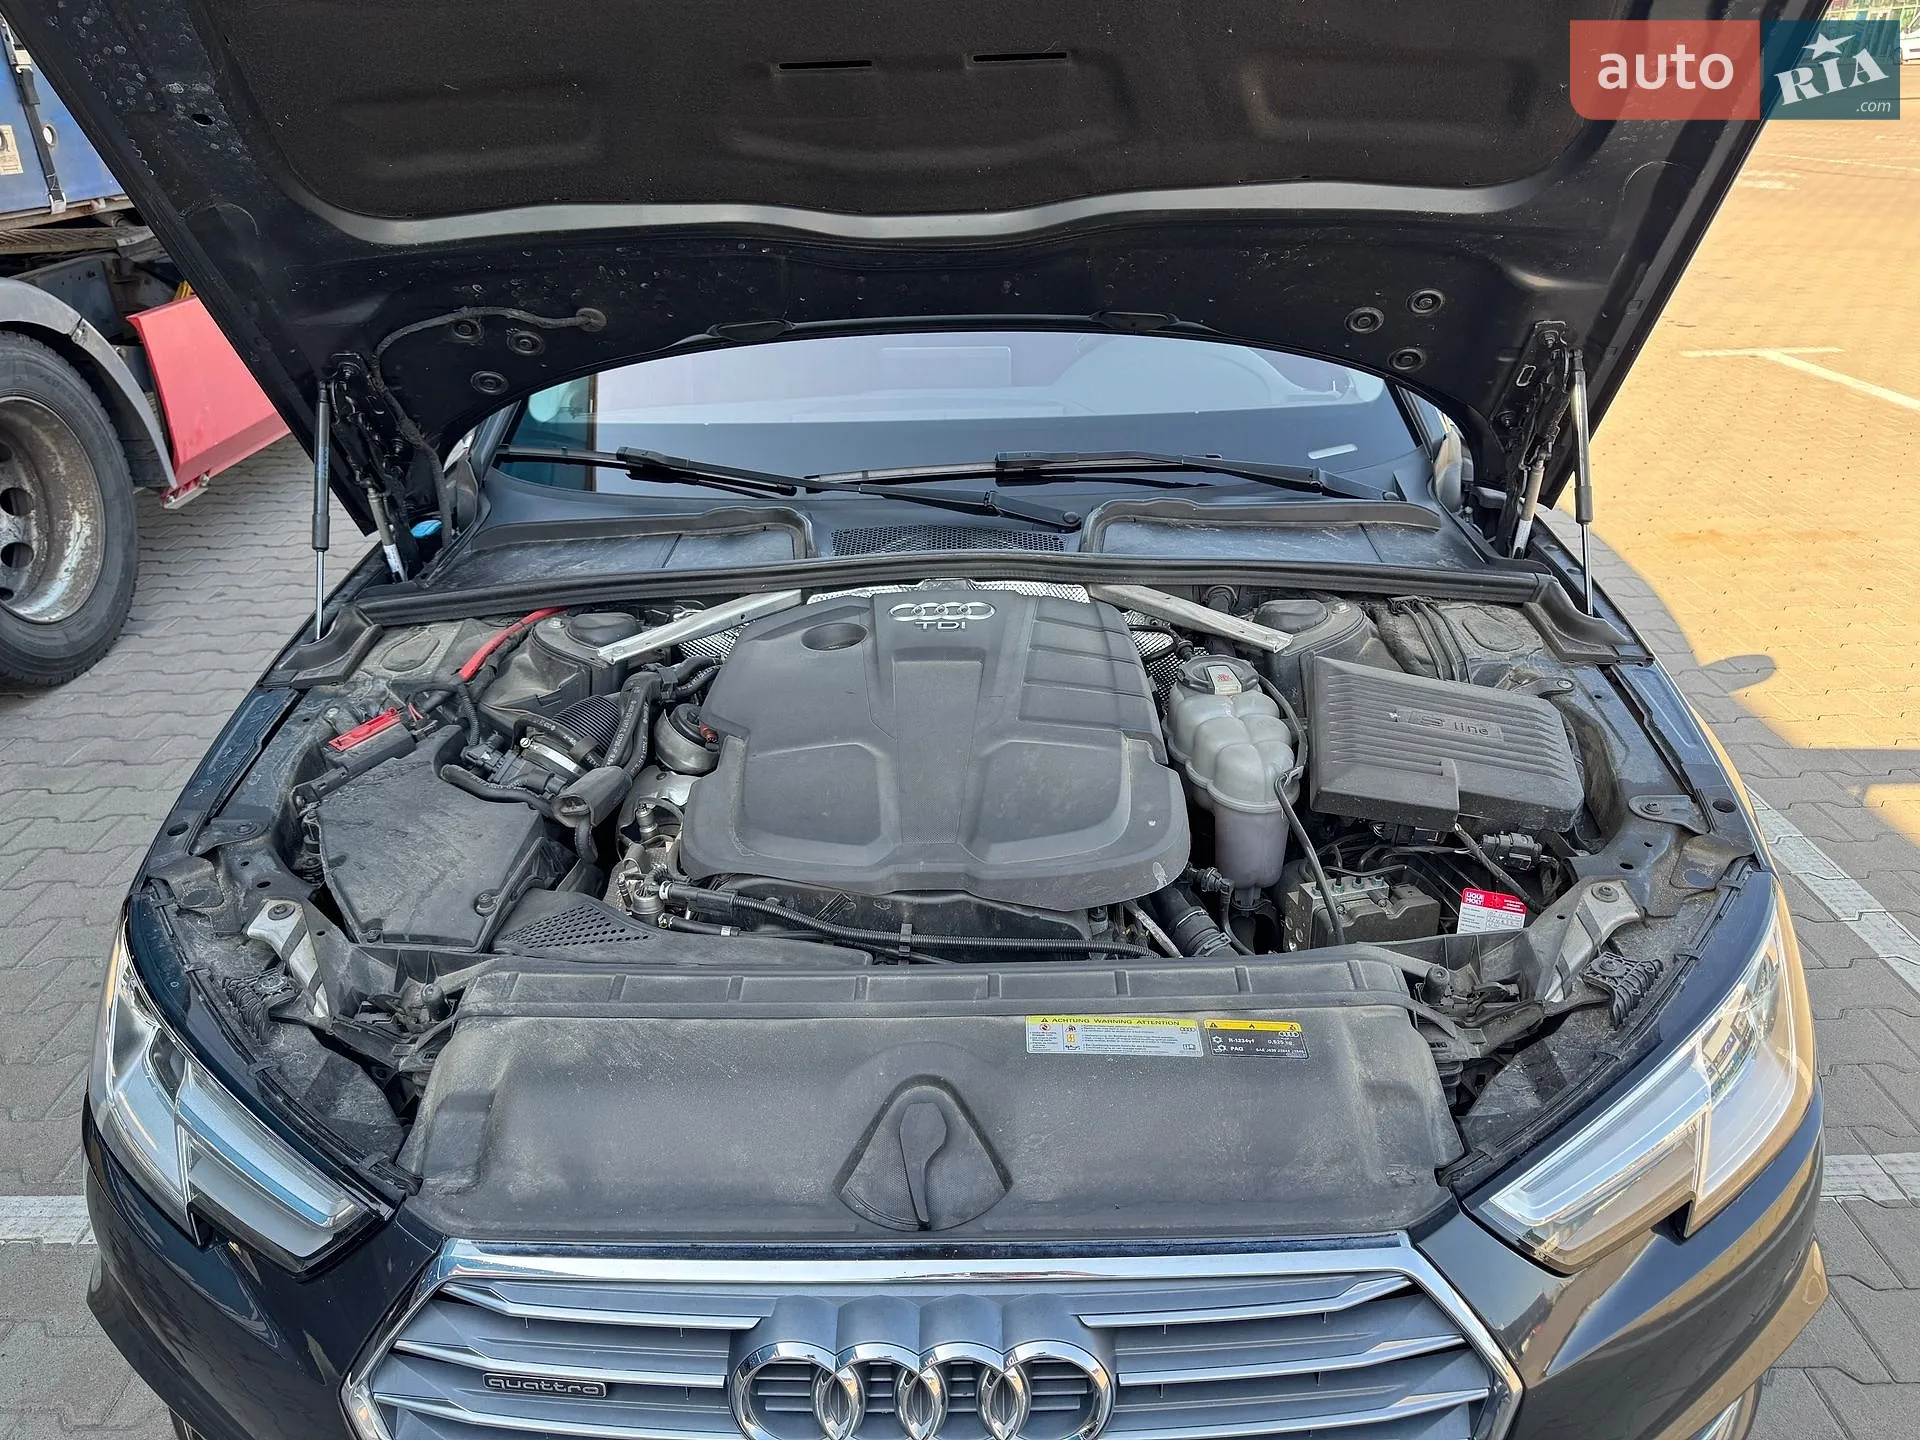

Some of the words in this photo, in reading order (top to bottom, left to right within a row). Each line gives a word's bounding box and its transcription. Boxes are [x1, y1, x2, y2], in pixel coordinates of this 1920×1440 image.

[915, 621, 966, 630] TDI
[1454, 721, 1489, 736] line
[488, 1377, 599, 1395] quattro
